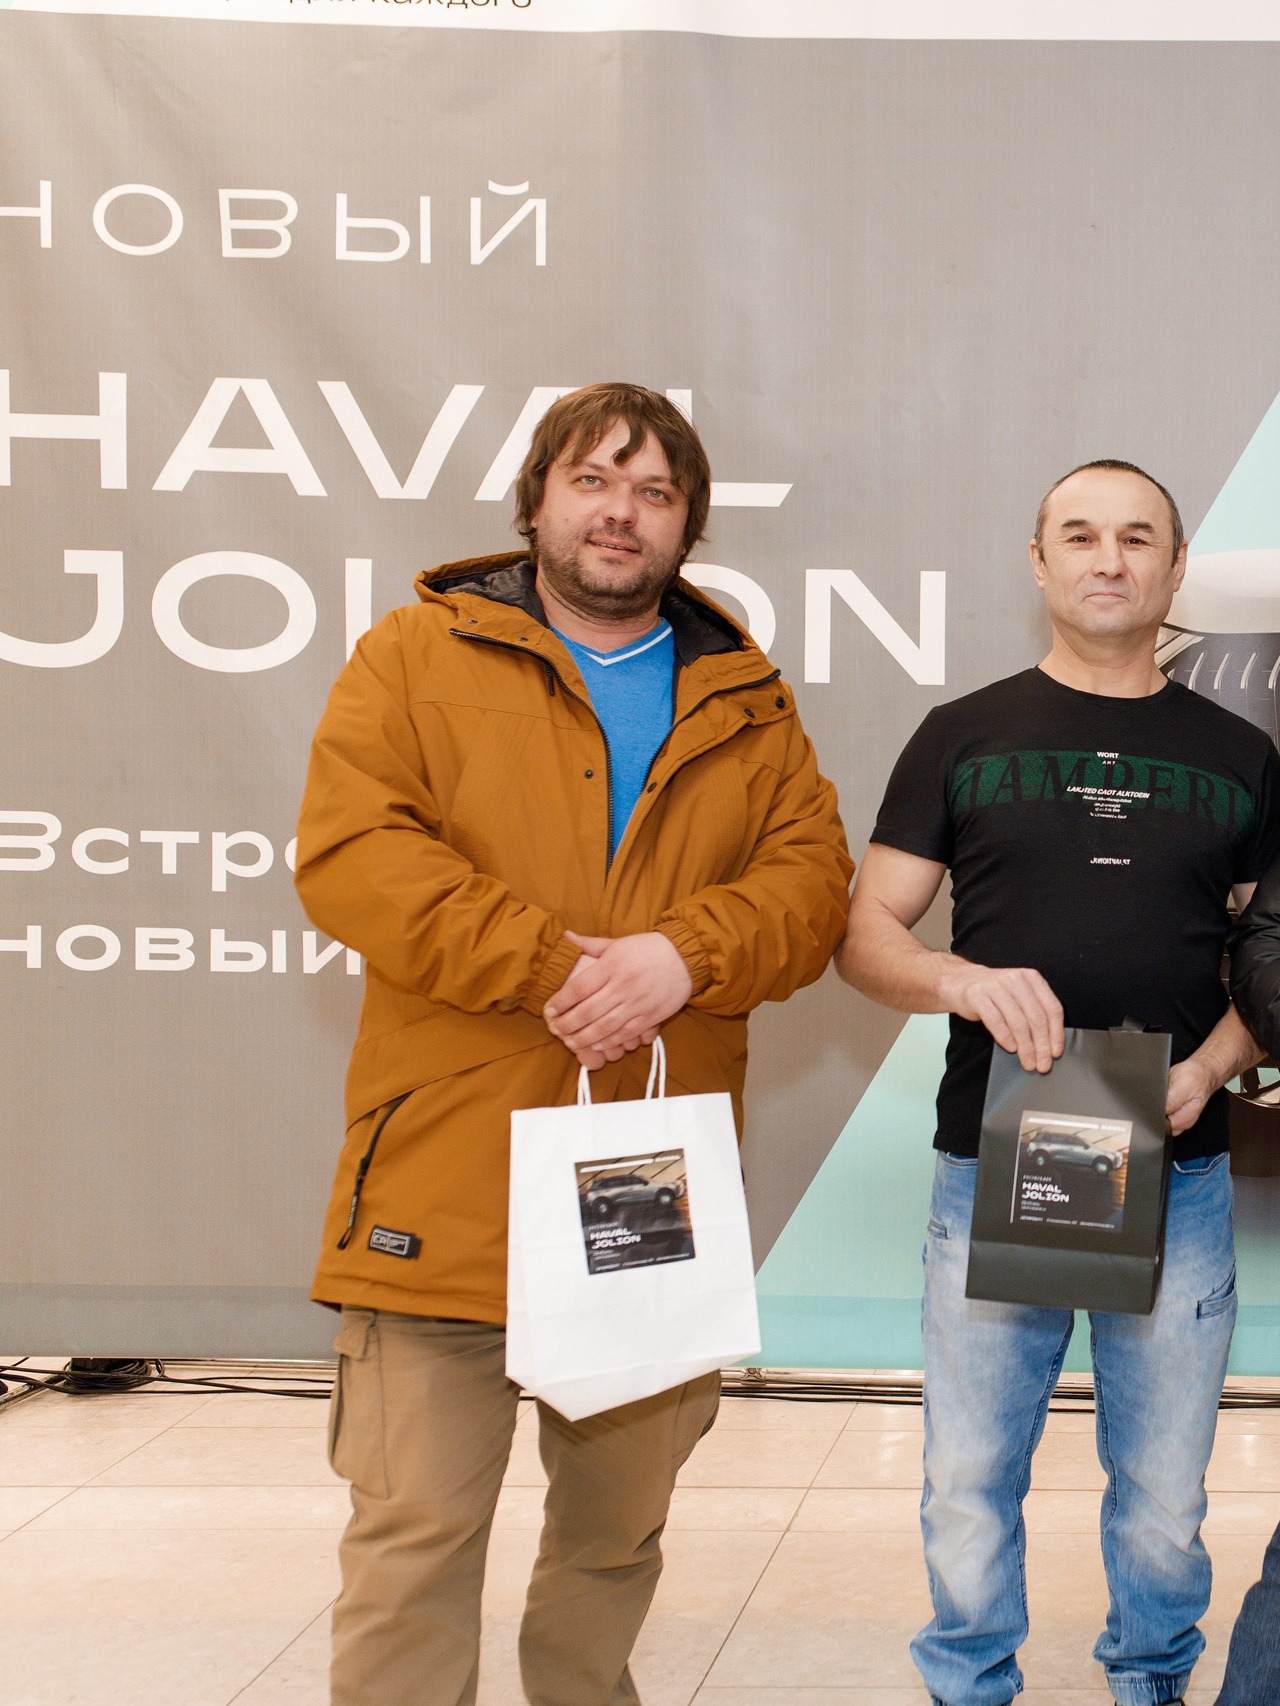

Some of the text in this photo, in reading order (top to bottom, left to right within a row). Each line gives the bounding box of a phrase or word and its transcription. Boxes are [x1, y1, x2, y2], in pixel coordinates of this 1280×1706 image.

[0, 180, 547, 267] НОВЫЙ
[0, 549, 947, 686] JOON
[0, 810, 298, 892] Встр
[1022, 1181, 1063, 1194] HAVAL
[1021, 1190, 1070, 1203] JOLION
[589, 1227, 632, 1241] HAVAL
[591, 1234, 642, 1250] JOLION
